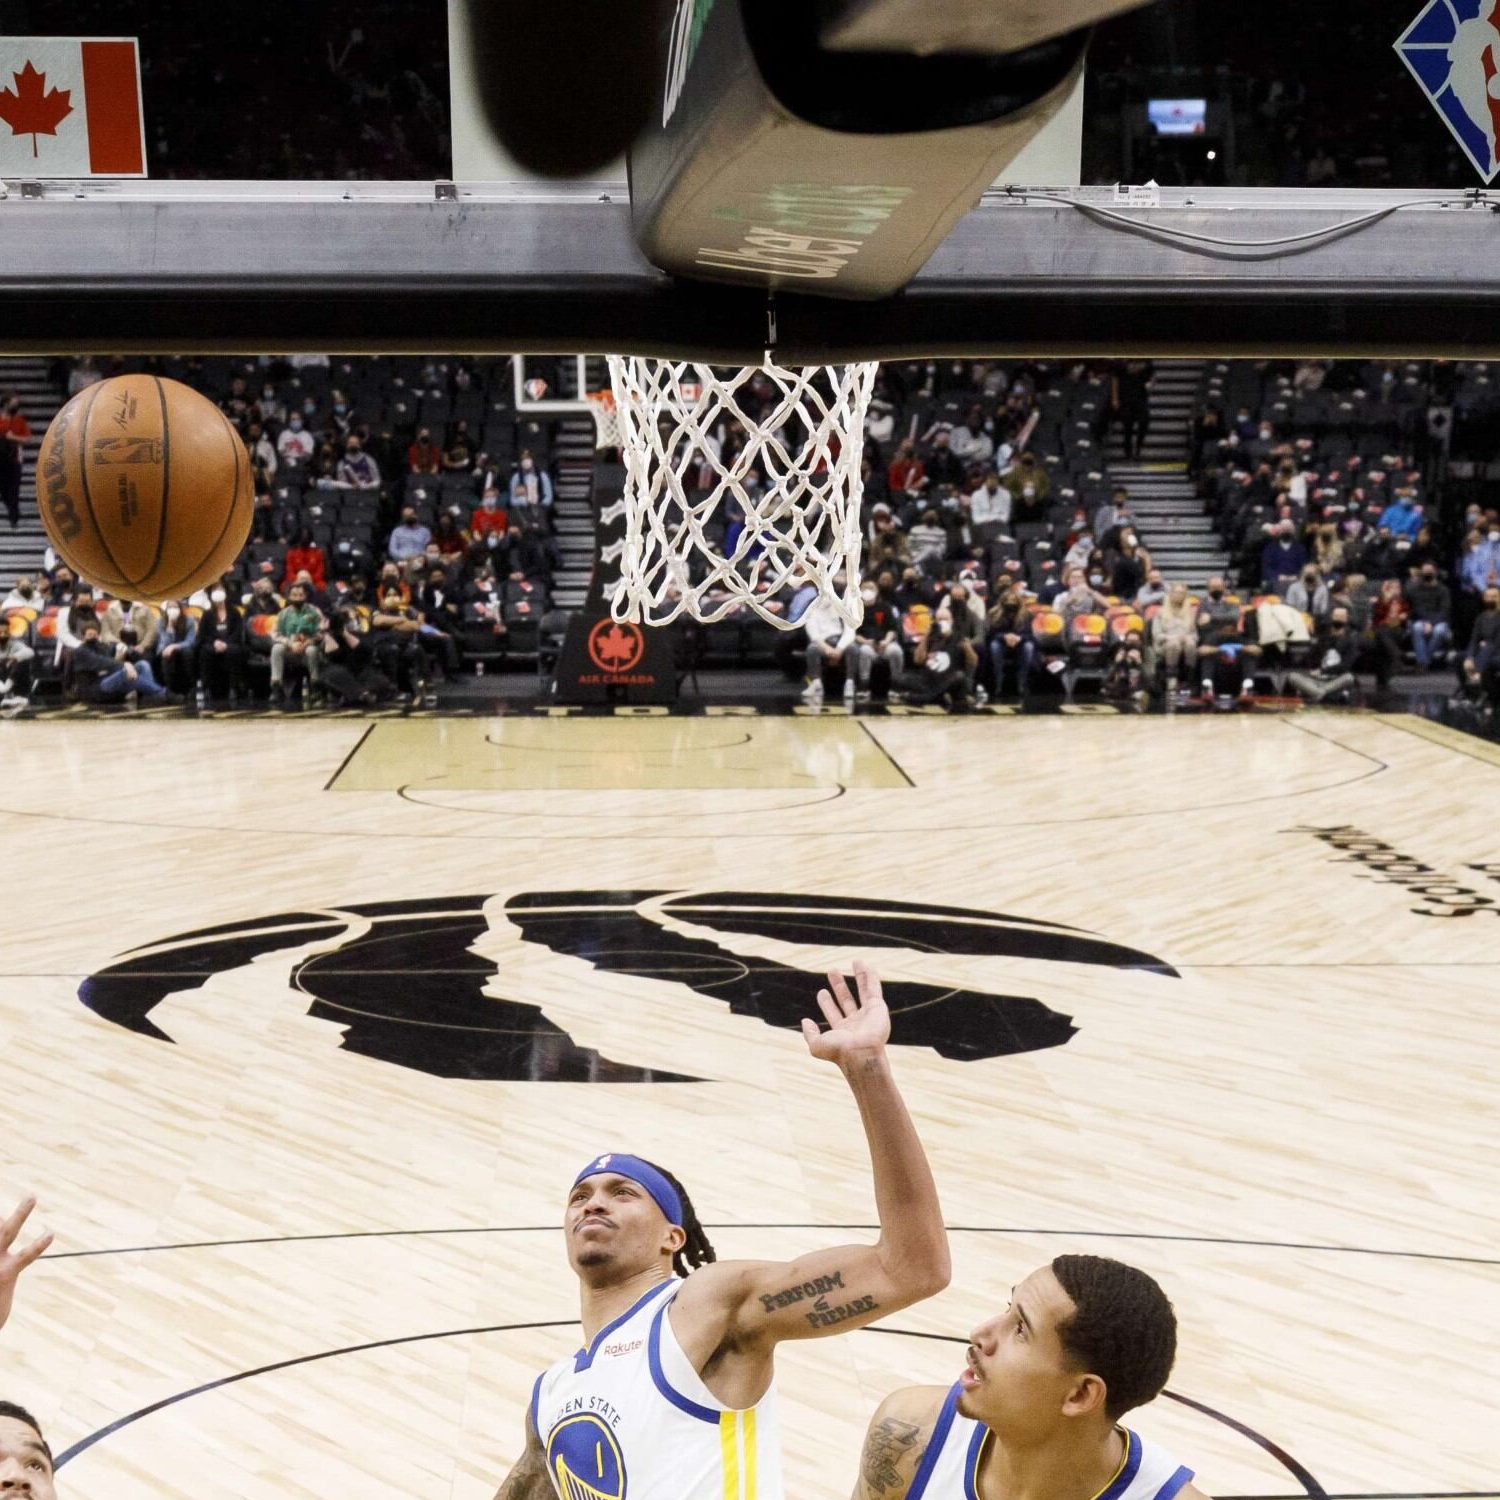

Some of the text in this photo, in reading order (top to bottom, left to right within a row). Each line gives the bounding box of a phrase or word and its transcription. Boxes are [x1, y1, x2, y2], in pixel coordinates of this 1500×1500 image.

[579, 674, 654, 684] AIR CANADA
[759, 1270, 847, 1314] PERFORM
[603, 1338, 644, 1356] Rakute
[588, 1396, 623, 1430] STATE
